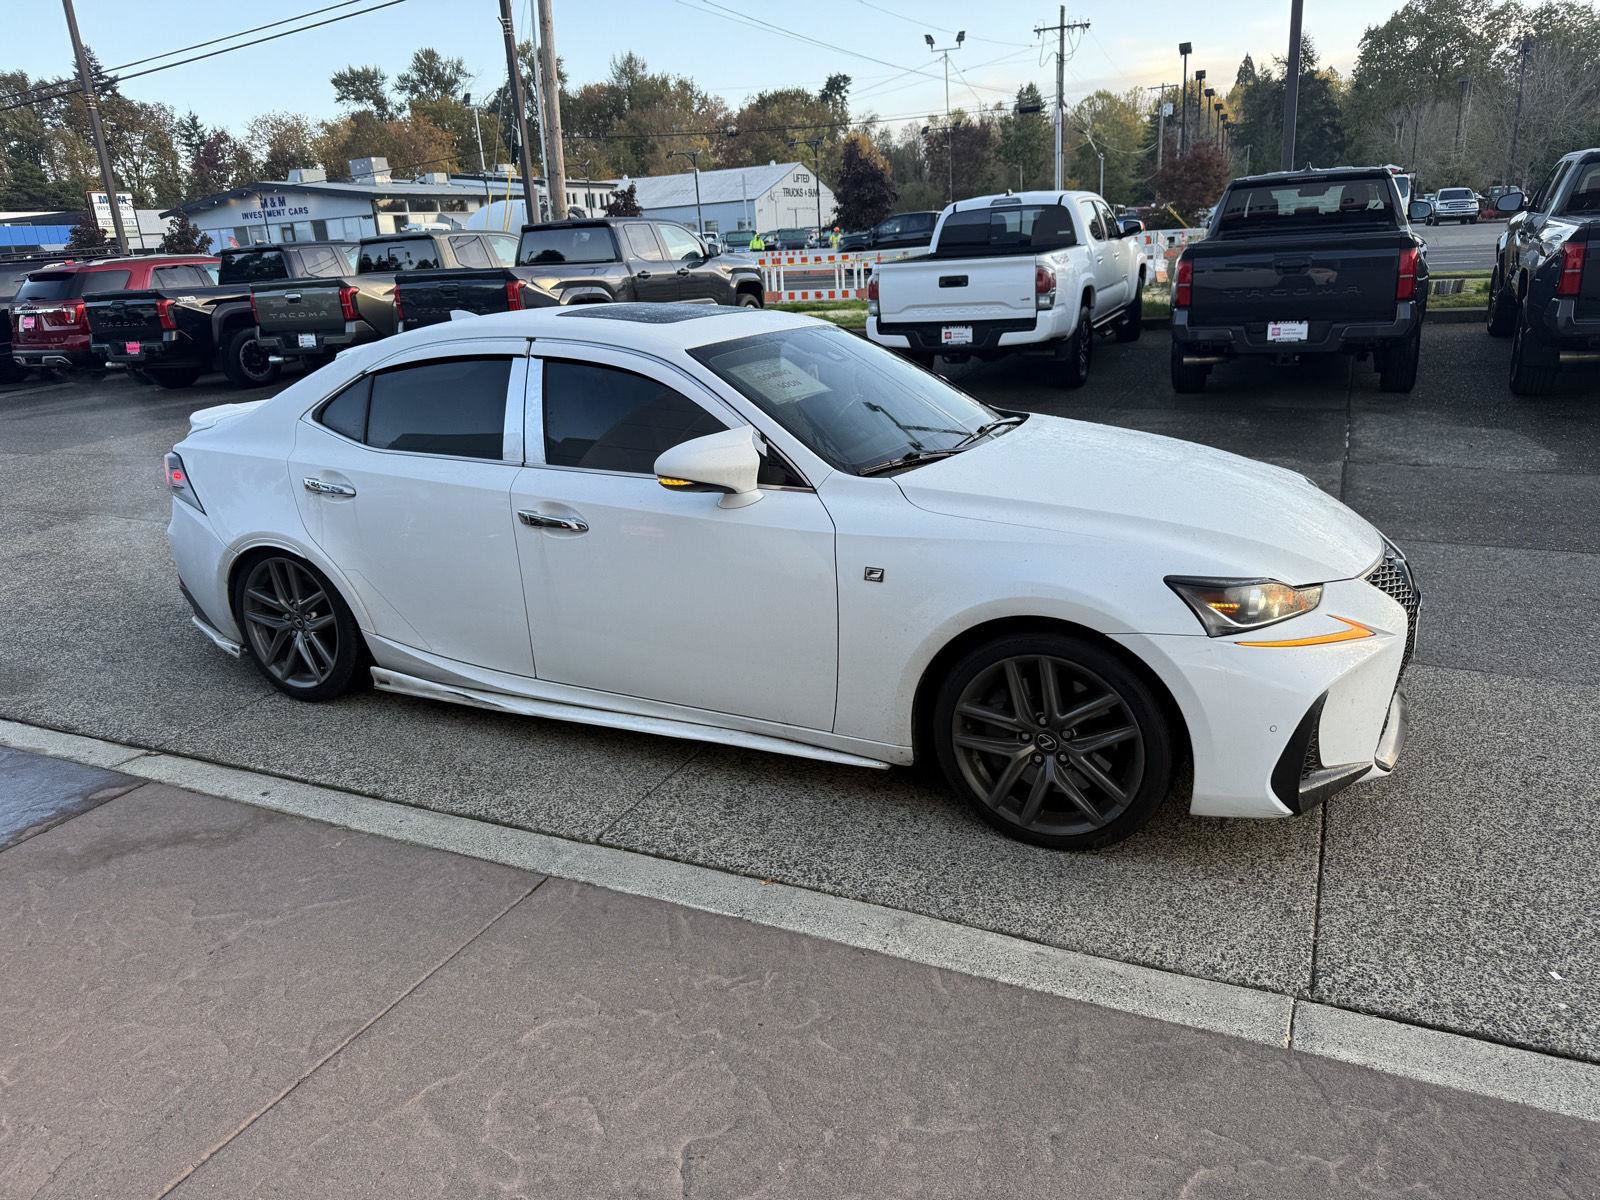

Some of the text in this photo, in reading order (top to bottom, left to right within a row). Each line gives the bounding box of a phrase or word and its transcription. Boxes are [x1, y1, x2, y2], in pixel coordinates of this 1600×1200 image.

[793, 173, 809, 183] LIFTED
[783, 188, 803, 197] TRUCKS
[98, 195, 126, 204] MM
[288, 206, 308, 215] CARS
[1222, 286, 1363, 298] TACOMA
[268, 310, 328, 319] TACOMA
